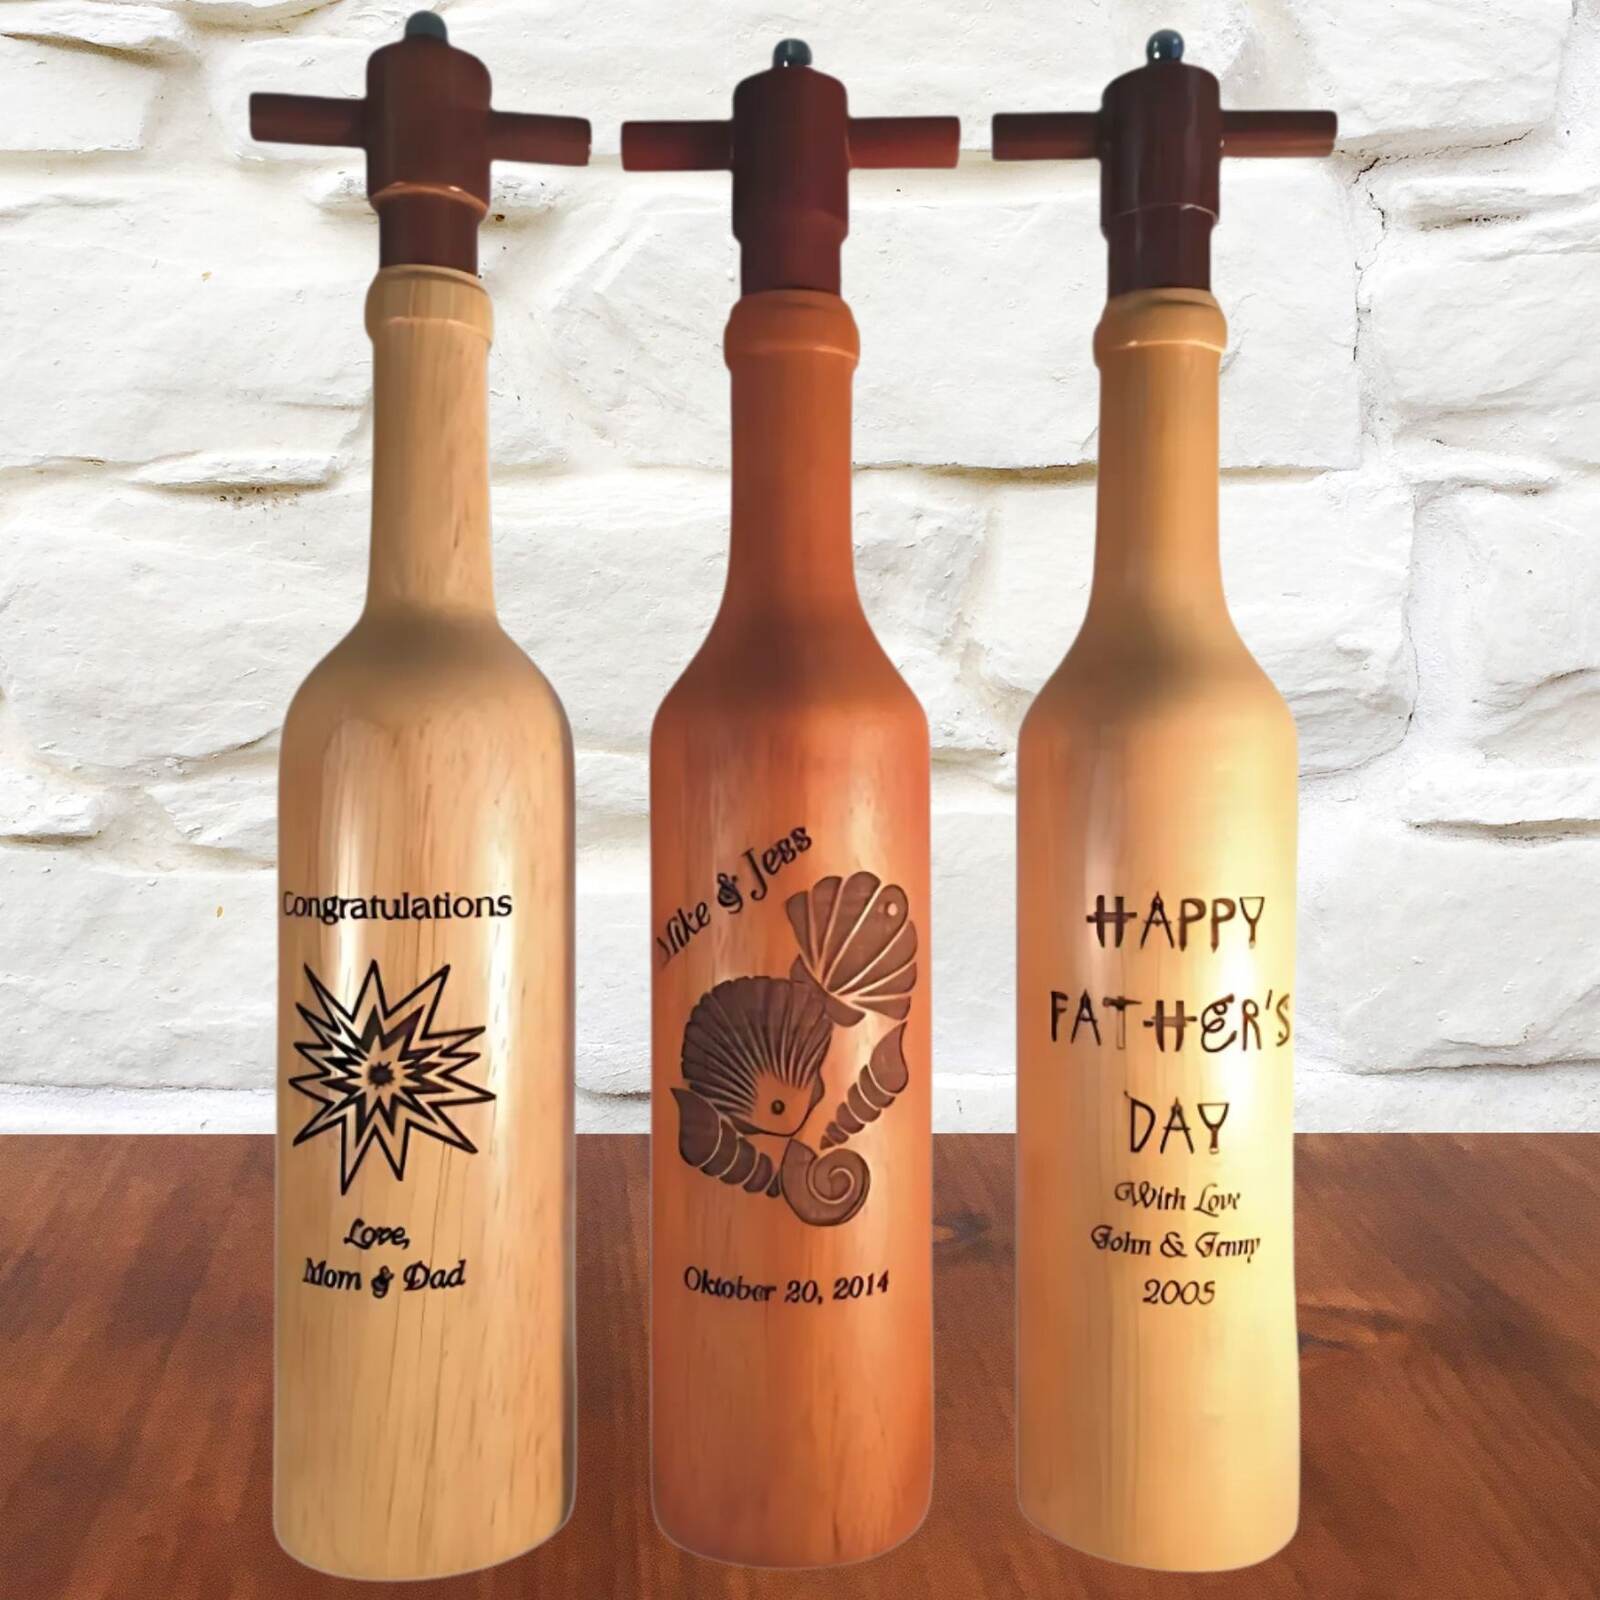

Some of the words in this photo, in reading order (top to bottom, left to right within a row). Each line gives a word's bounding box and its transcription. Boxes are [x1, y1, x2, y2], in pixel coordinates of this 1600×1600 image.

[717, 872, 744, 915] &
[742, 826, 813, 900] Jess
[283, 892, 513, 925] Congratulations
[1086, 891, 1265, 953] HAPPY
[1050, 988, 1291, 1053] FATHER'S
[1123, 1090, 1230, 1155] DAY
[1114, 1181, 1186, 1211] With
[1193, 1182, 1241, 1217] Love
[344, 1217, 410, 1251] Love,
[1091, 1224, 1152, 1256] John
[1159, 1231, 1188, 1258] &
[303, 1257, 362, 1291] Mom
[370, 1266, 395, 1299] &
[403, 1259, 467, 1292] Dad
[683, 1265, 777, 1301] Oktober
[784, 1279, 824, 1305] 20,
[833, 1270, 890, 1300] 2014
[1142, 1278, 1216, 1305] 2005
